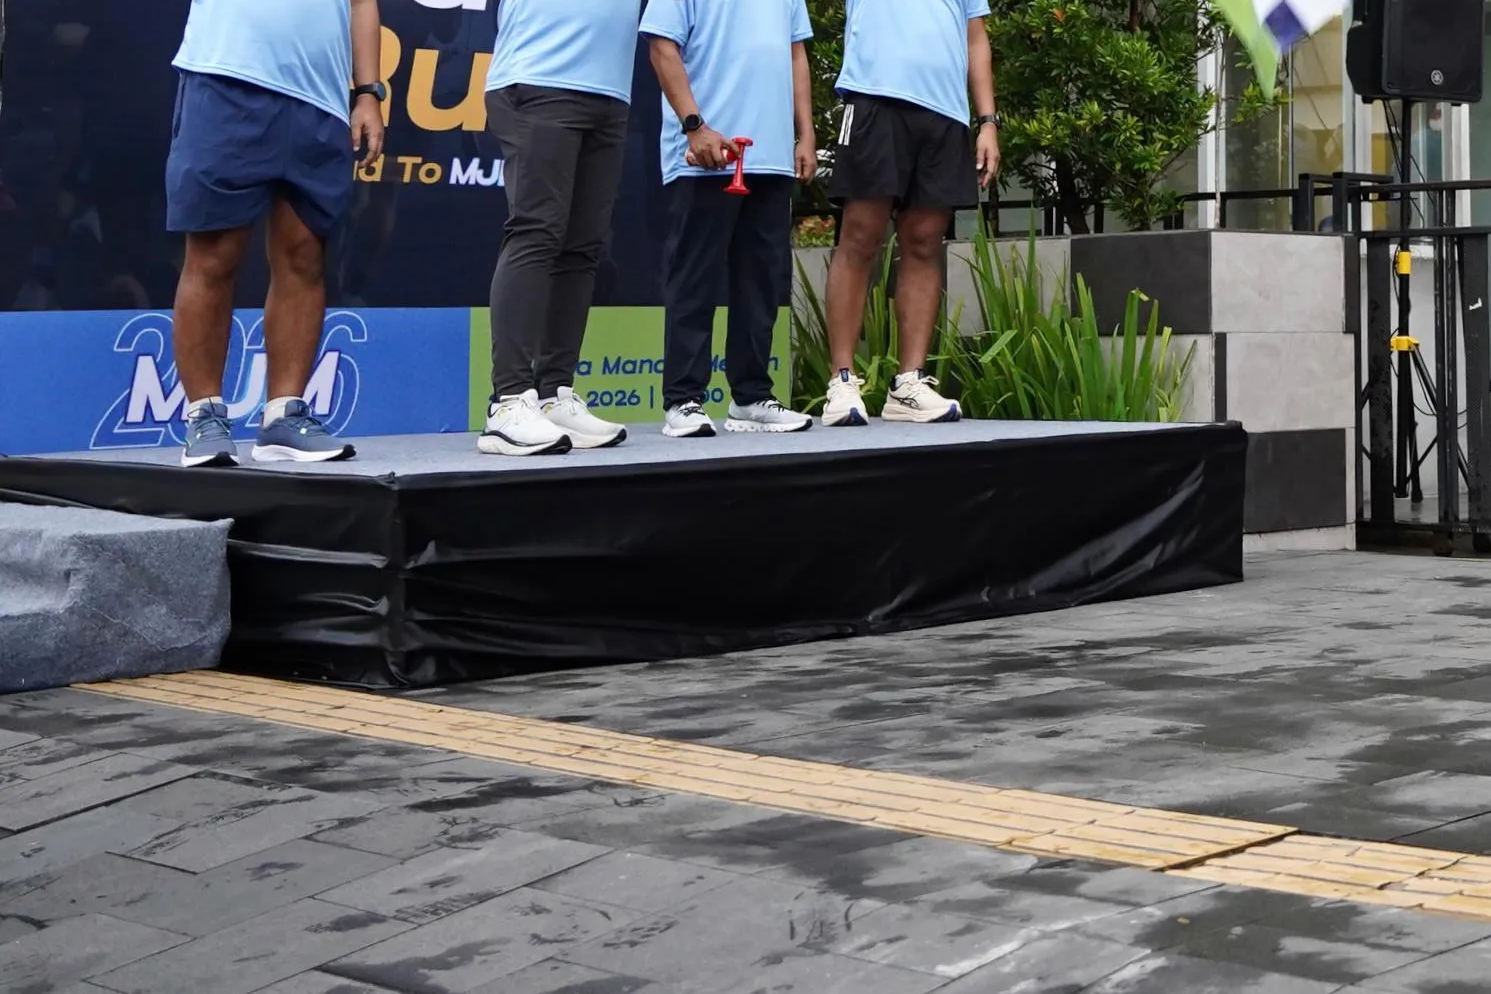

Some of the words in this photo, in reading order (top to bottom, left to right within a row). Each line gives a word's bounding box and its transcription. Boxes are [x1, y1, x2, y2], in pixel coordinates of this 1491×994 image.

[397, 156, 443, 185] To
[449, 158, 505, 187] MJ
[586, 389, 641, 407] 2026
